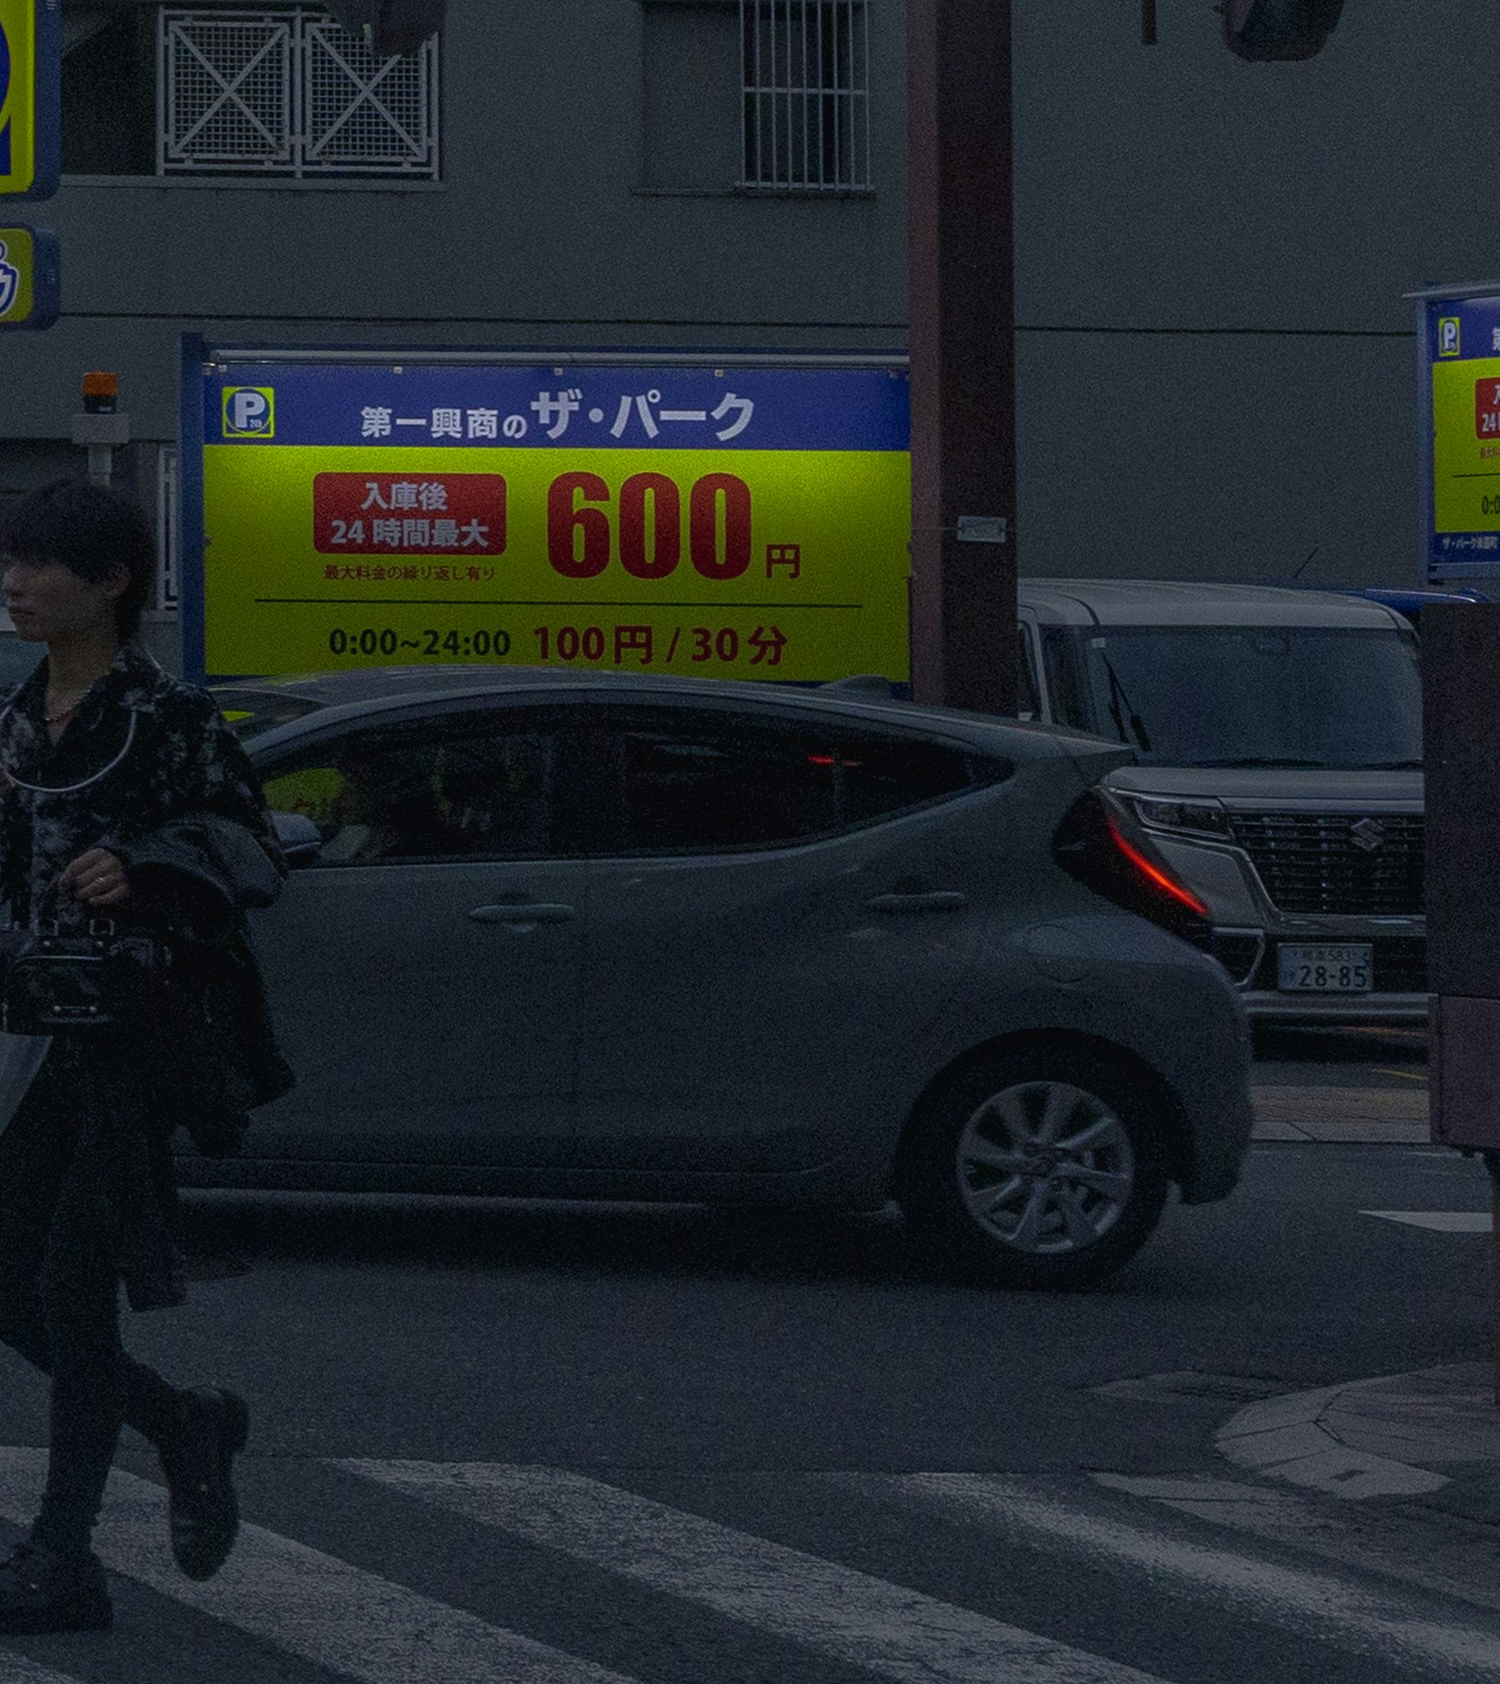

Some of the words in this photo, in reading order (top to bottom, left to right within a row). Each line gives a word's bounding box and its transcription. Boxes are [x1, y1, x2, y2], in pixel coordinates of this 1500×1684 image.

[234, 393, 266, 428] P
[360, 406, 527, 439] 第一興商の
[531, 388, 755, 441] ザ・パーク
[360, 481, 448, 511] 入庫後
[547, 471, 751, 579] 600
[766, 544, 800, 579] 円
[324, 565, 496, 582] 最大料金の繰り返し有り
[1299, 964, 1367, 987] 28-85
